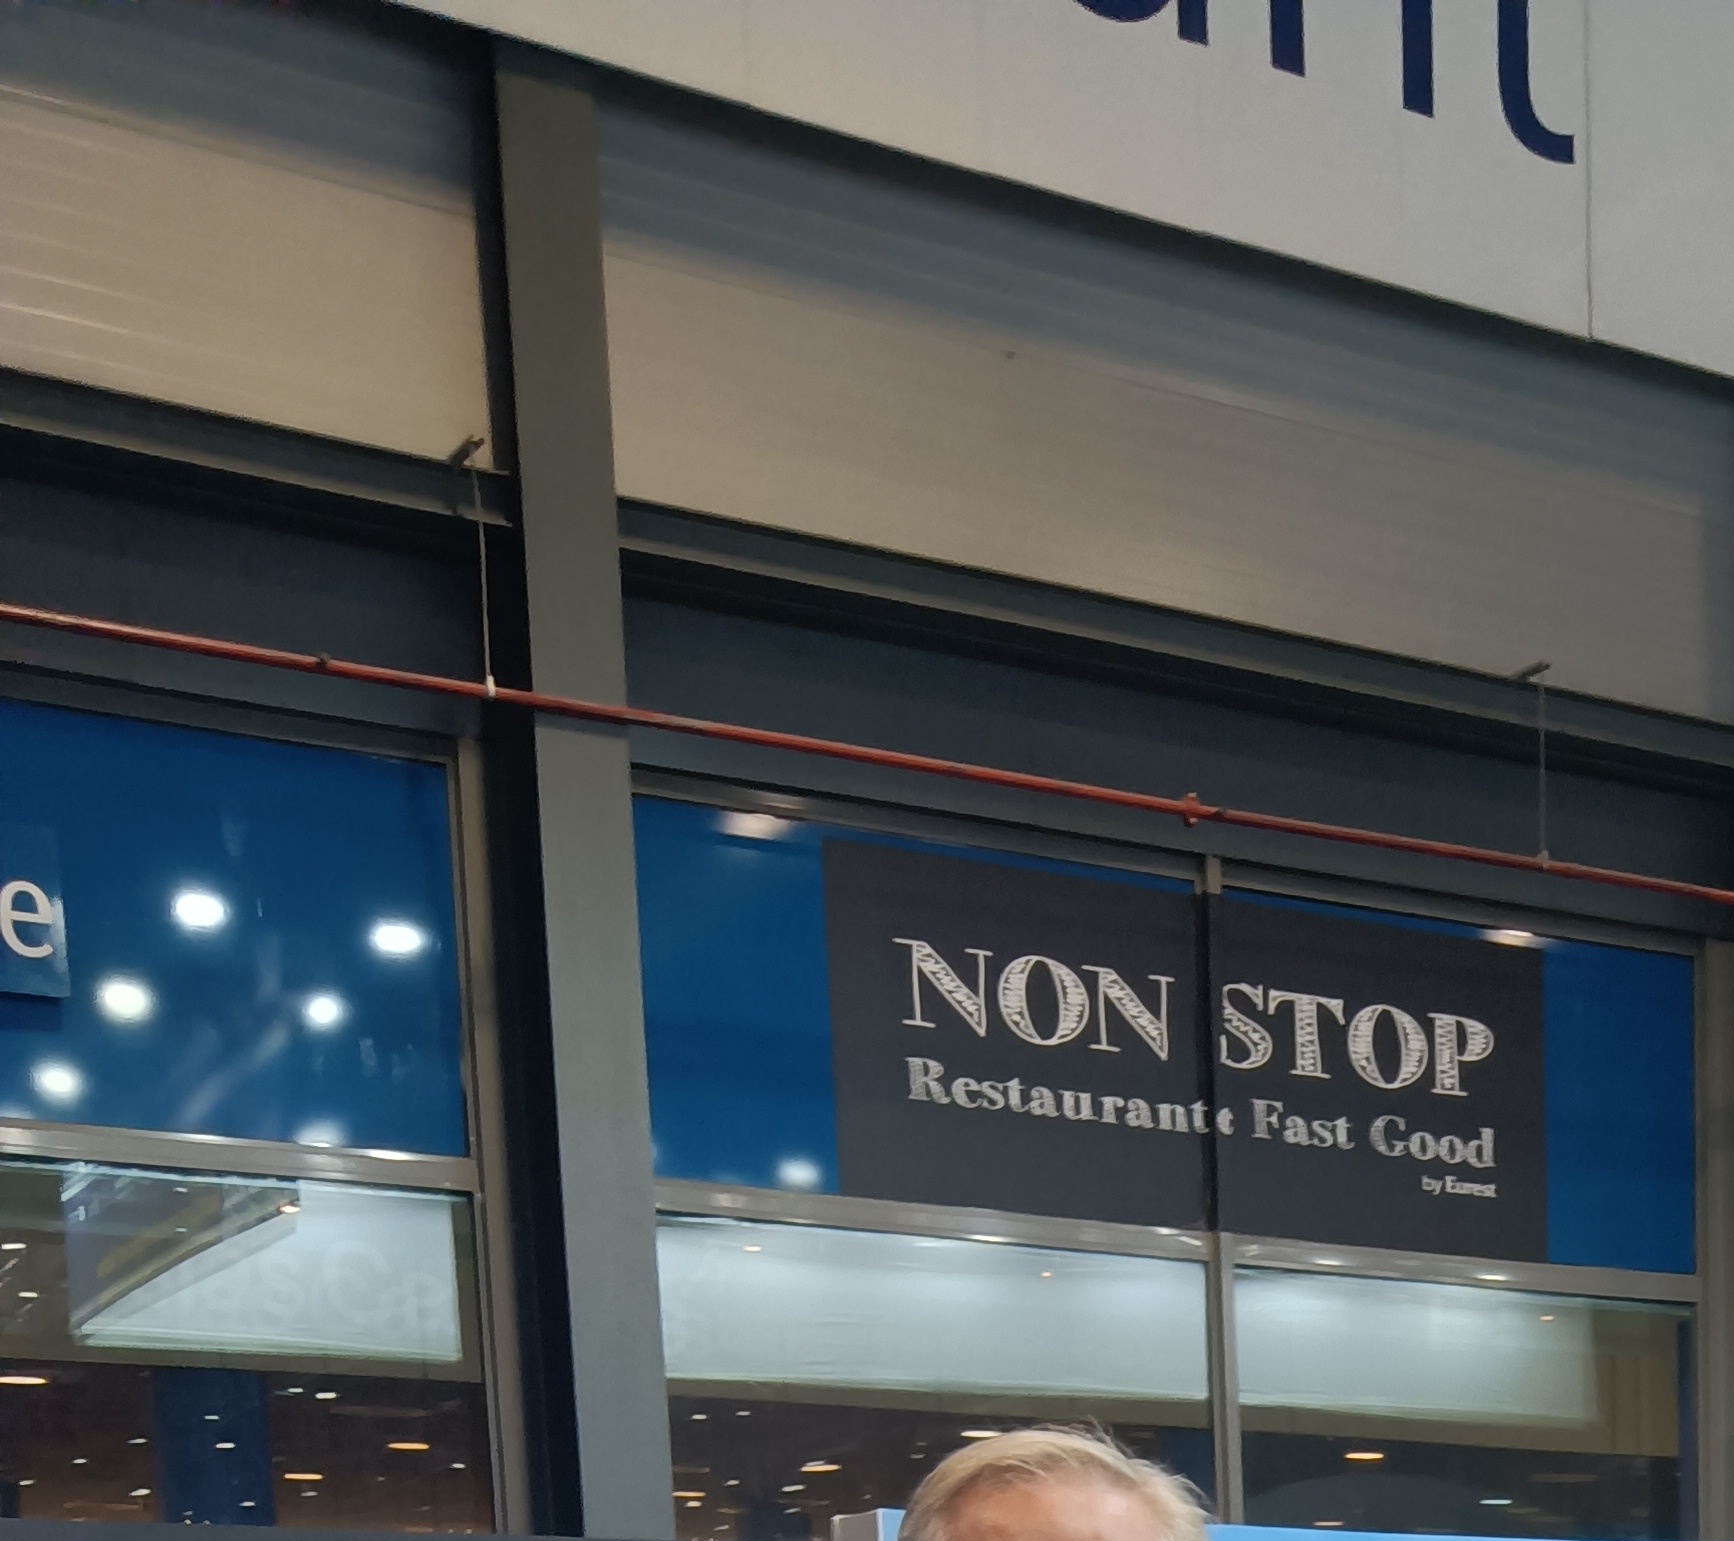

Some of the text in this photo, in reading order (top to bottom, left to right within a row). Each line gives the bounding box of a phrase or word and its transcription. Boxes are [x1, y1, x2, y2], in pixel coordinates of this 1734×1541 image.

[891, 937, 1495, 1096] NON STOP
[905, 1056, 1497, 1168] Restaurante Fast Good
